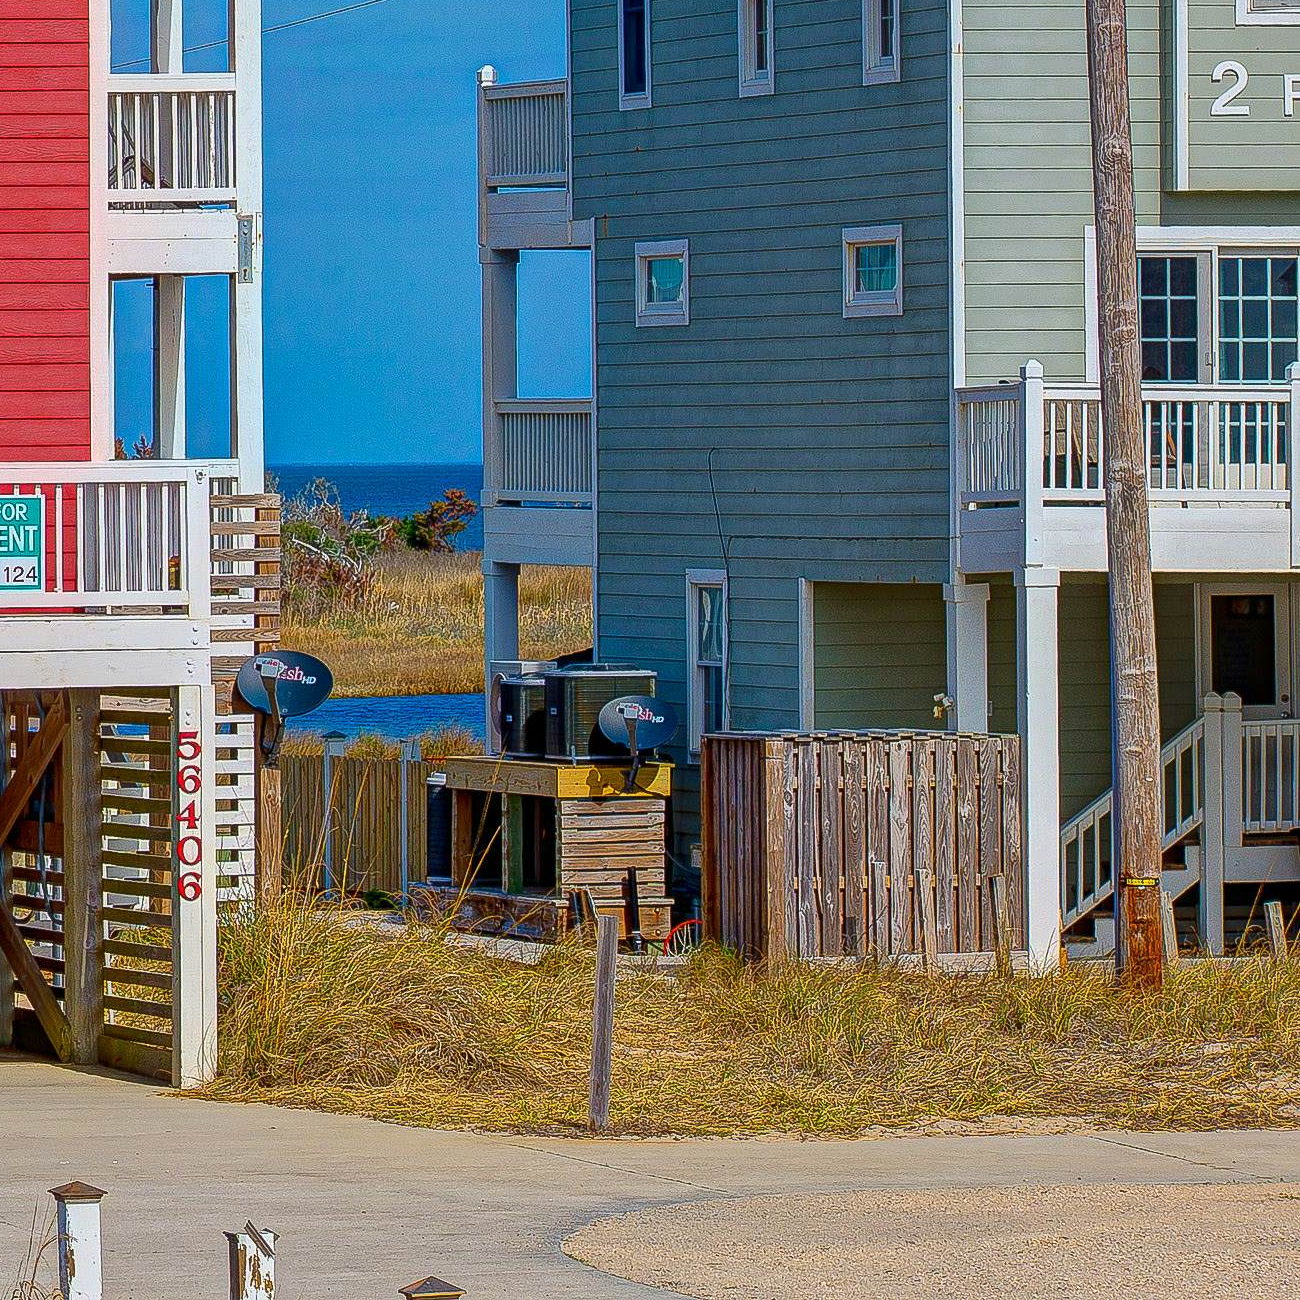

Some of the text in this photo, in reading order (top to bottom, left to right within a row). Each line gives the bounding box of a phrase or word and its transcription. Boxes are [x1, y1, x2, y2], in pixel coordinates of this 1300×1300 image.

[1209, 60, 1250, 117] 2
[3, 566, 38, 583] 124
[301, 675, 317, 684] HD
[176, 731, 202, 901] 56406
